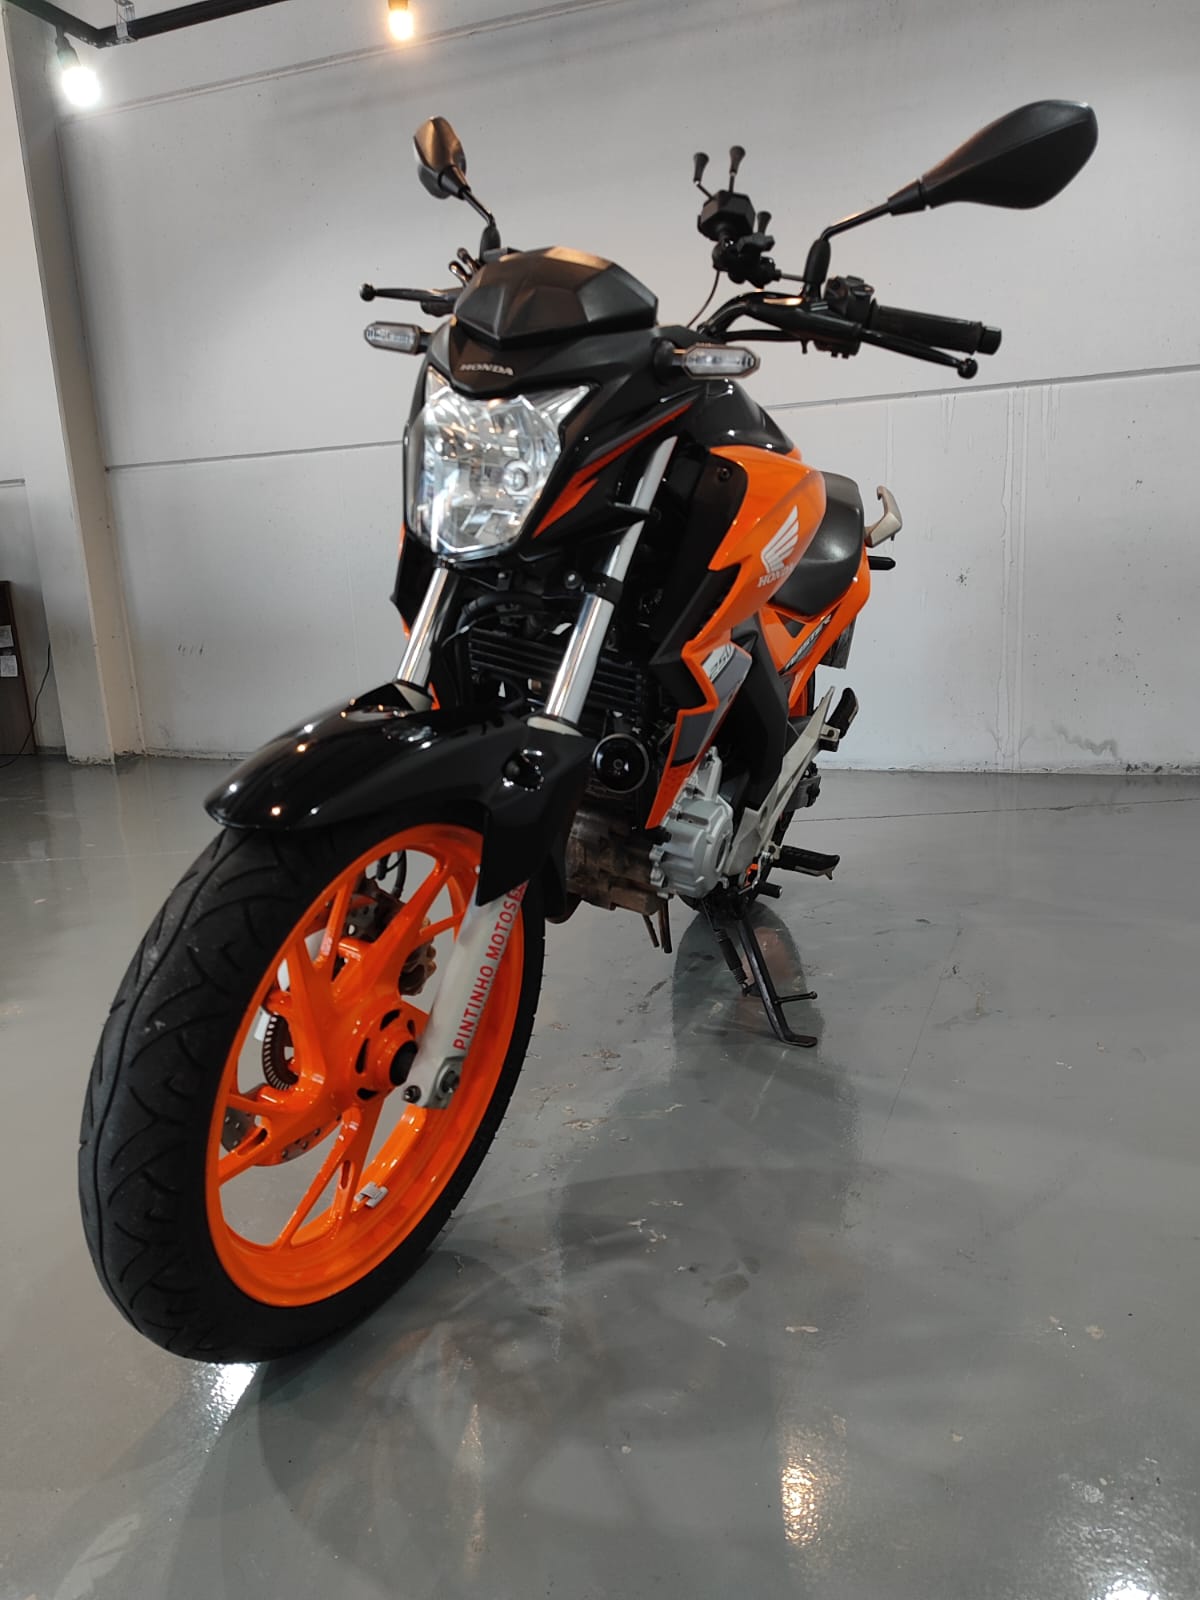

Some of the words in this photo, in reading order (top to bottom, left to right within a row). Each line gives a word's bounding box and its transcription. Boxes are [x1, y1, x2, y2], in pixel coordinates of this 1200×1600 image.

[460, 363, 514, 376] HONDA
[453, 965, 494, 1051] PINTINHO
[485, 900, 516, 961] MOTOS
